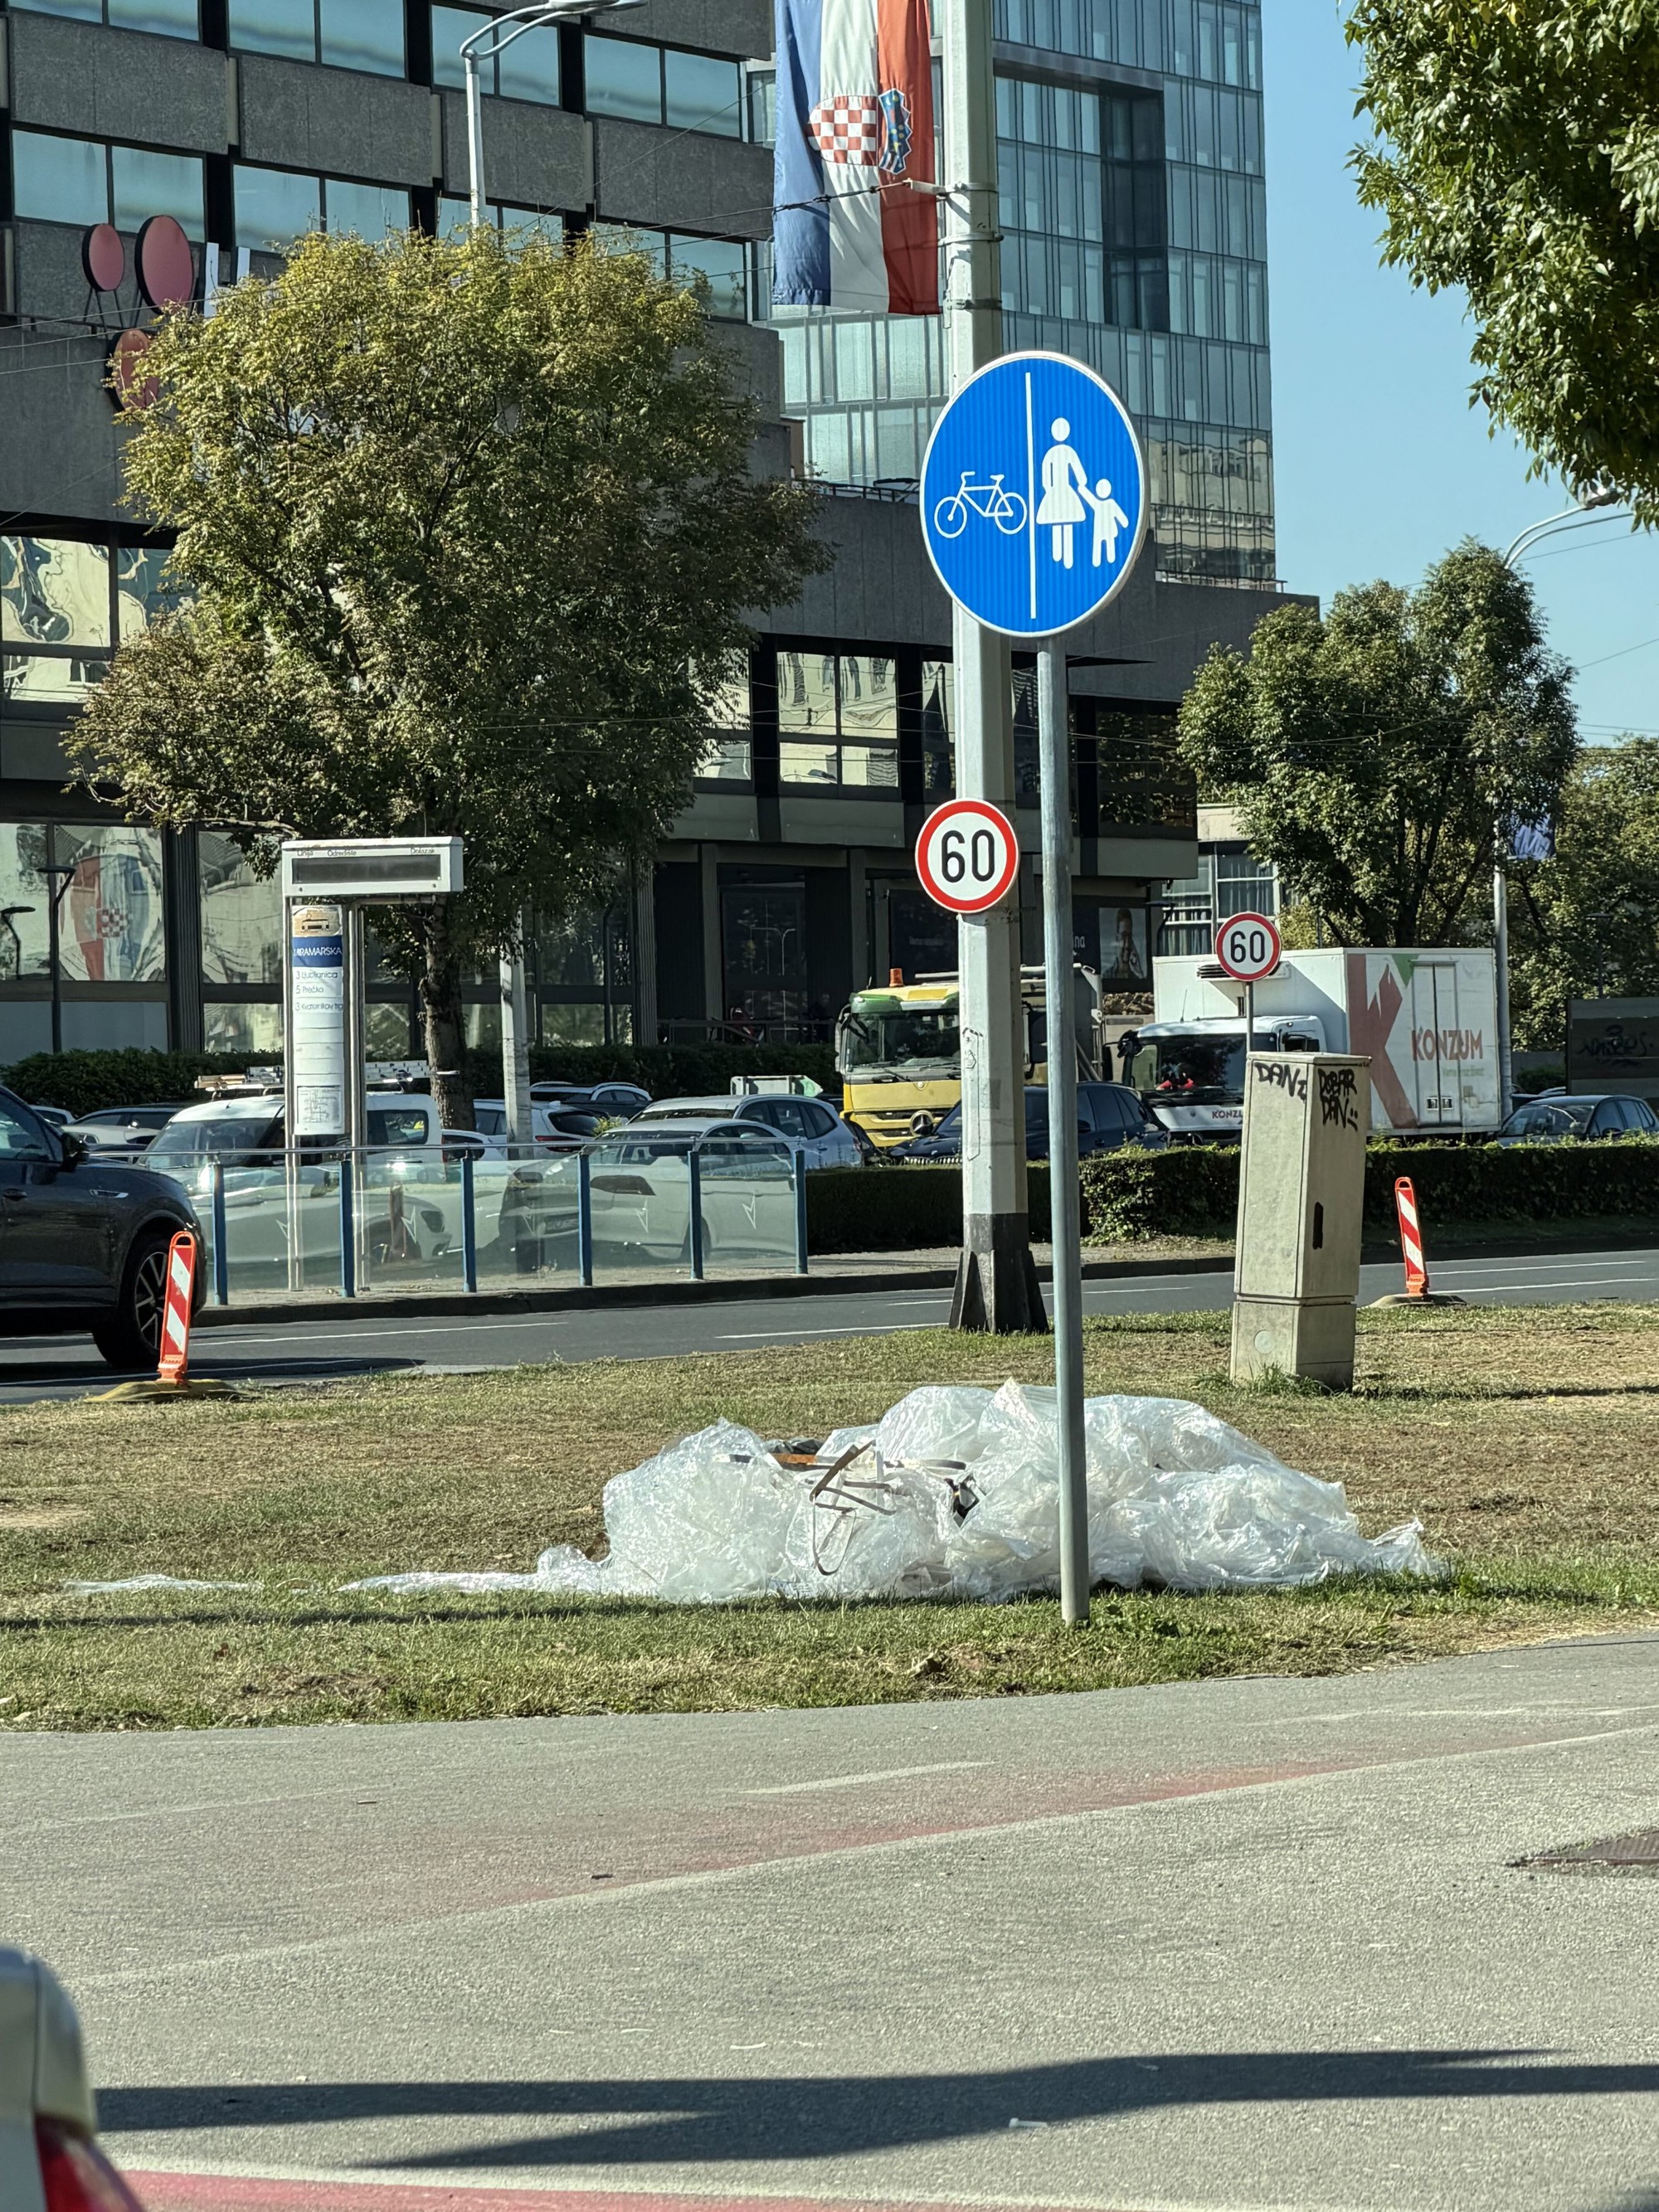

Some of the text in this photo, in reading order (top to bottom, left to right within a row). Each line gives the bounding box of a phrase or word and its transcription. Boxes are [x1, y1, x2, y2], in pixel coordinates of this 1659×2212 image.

[941, 829, 995, 883] 60
[1230, 930, 1266, 964] 60
[295, 970, 300, 980] 3
[295, 984, 301, 994] 5
[1411, 1028, 1483, 1061] KONZUM
[1212, 1110, 1243, 1119] KONZ
[1321, 1094, 1350, 1129] DAN
